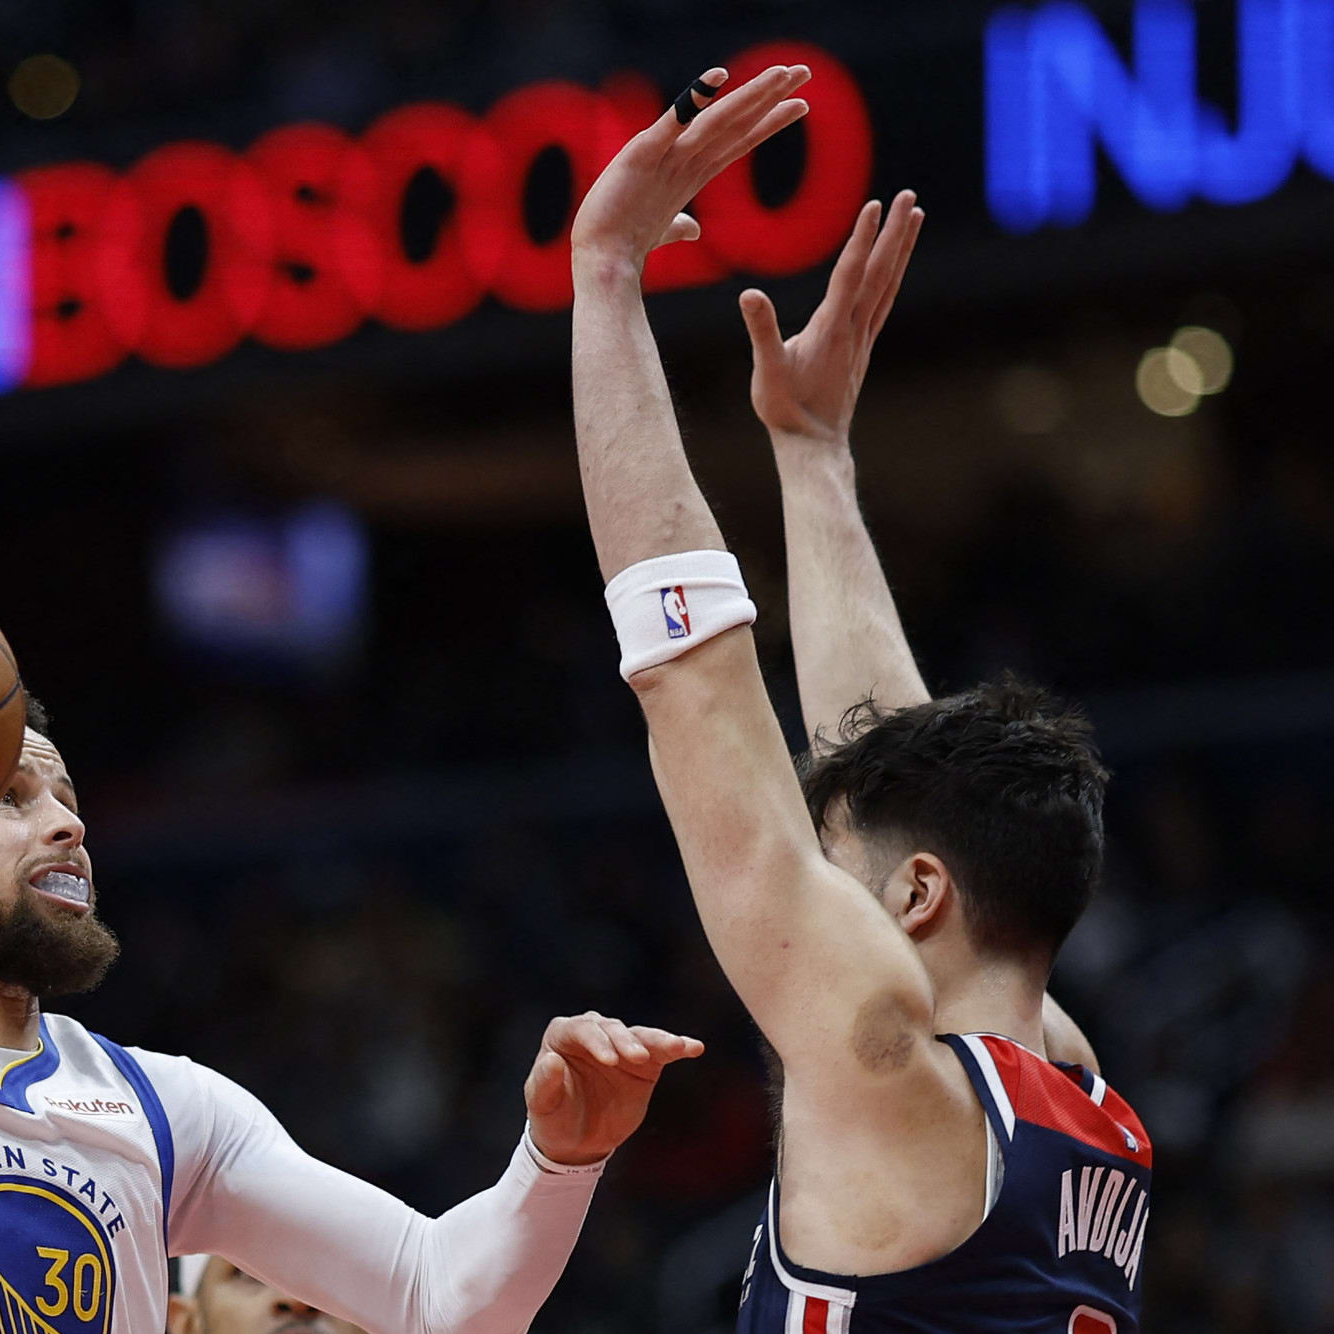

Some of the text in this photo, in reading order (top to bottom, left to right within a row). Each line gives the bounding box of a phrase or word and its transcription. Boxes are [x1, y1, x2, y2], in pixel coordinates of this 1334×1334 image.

[43, 1157, 124, 1239] STATE
[1057, 1165, 1150, 1292] AVDIJA
[35, 1245, 103, 1322] 30
